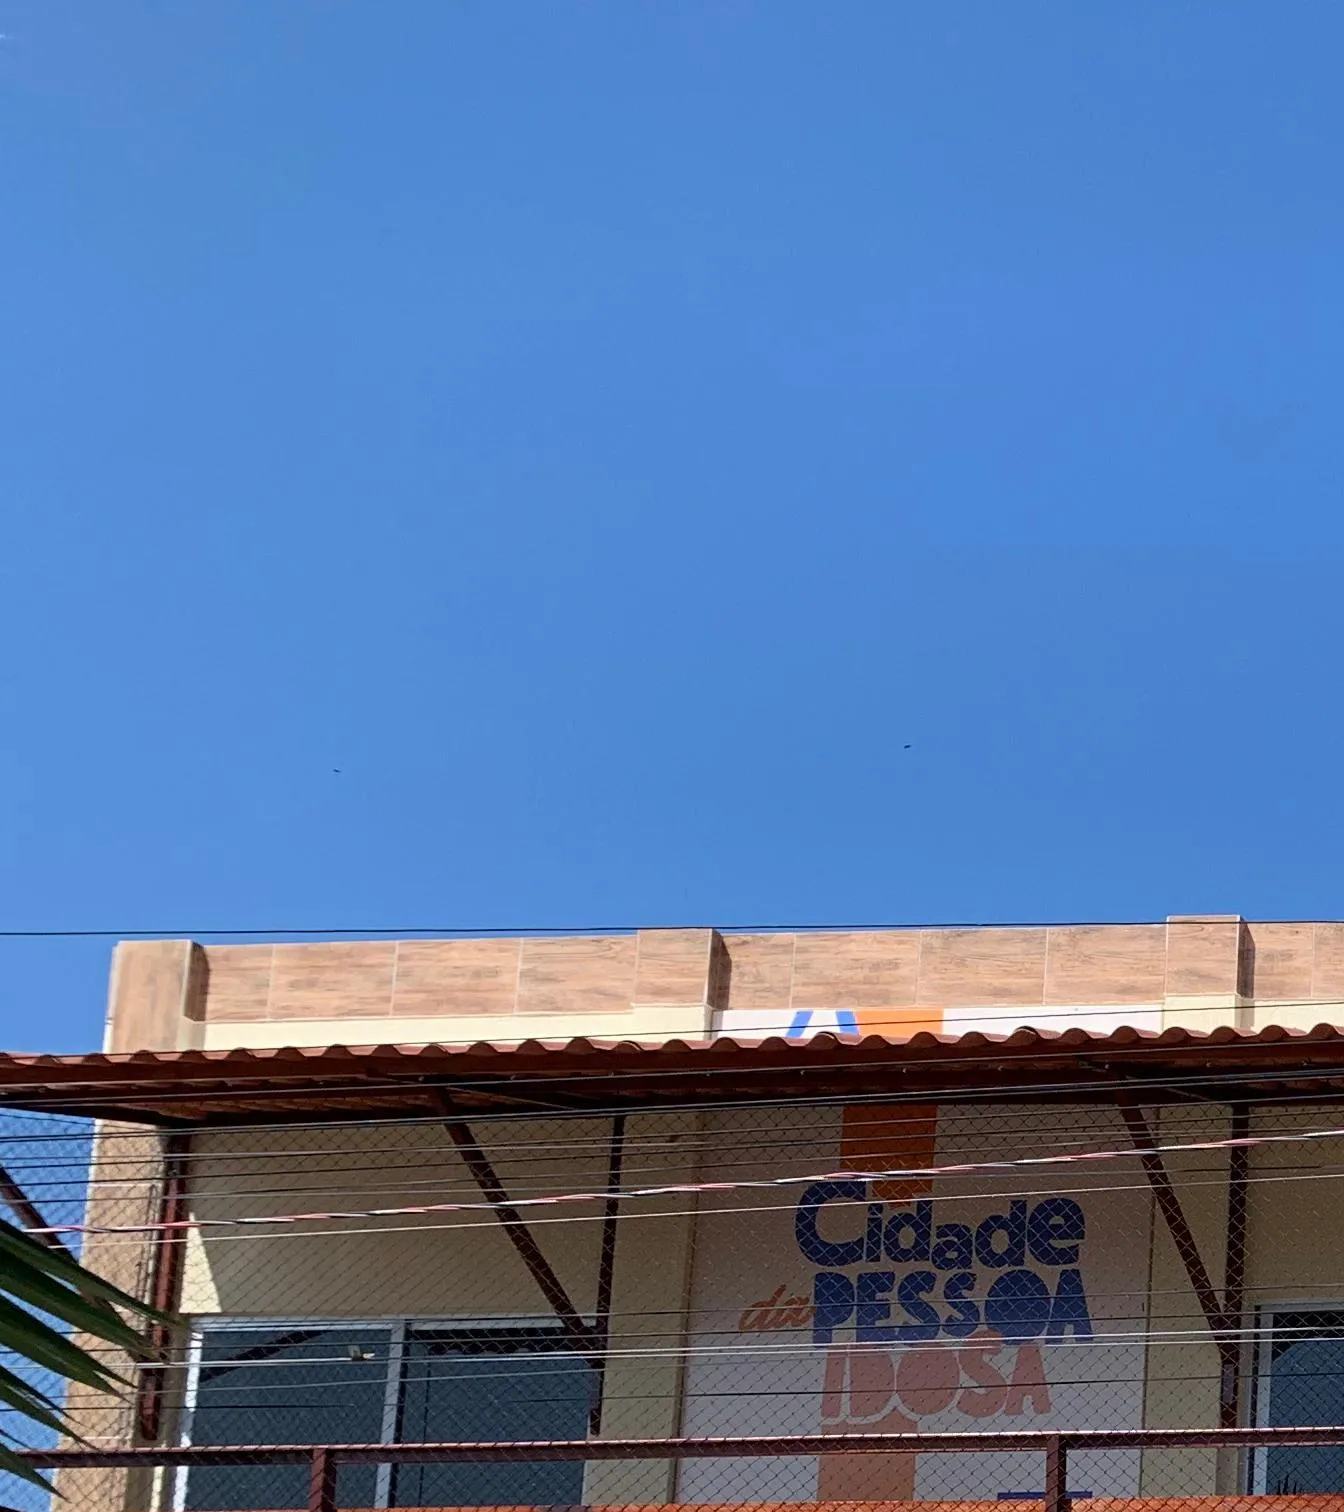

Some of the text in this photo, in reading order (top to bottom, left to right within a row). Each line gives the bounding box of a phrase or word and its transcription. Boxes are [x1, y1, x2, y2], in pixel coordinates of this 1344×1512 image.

[795, 1181, 1085, 1270] Cidade
[813, 1269, 1094, 1348] PESSOA
[820, 1329, 1051, 1418] IDOSA
